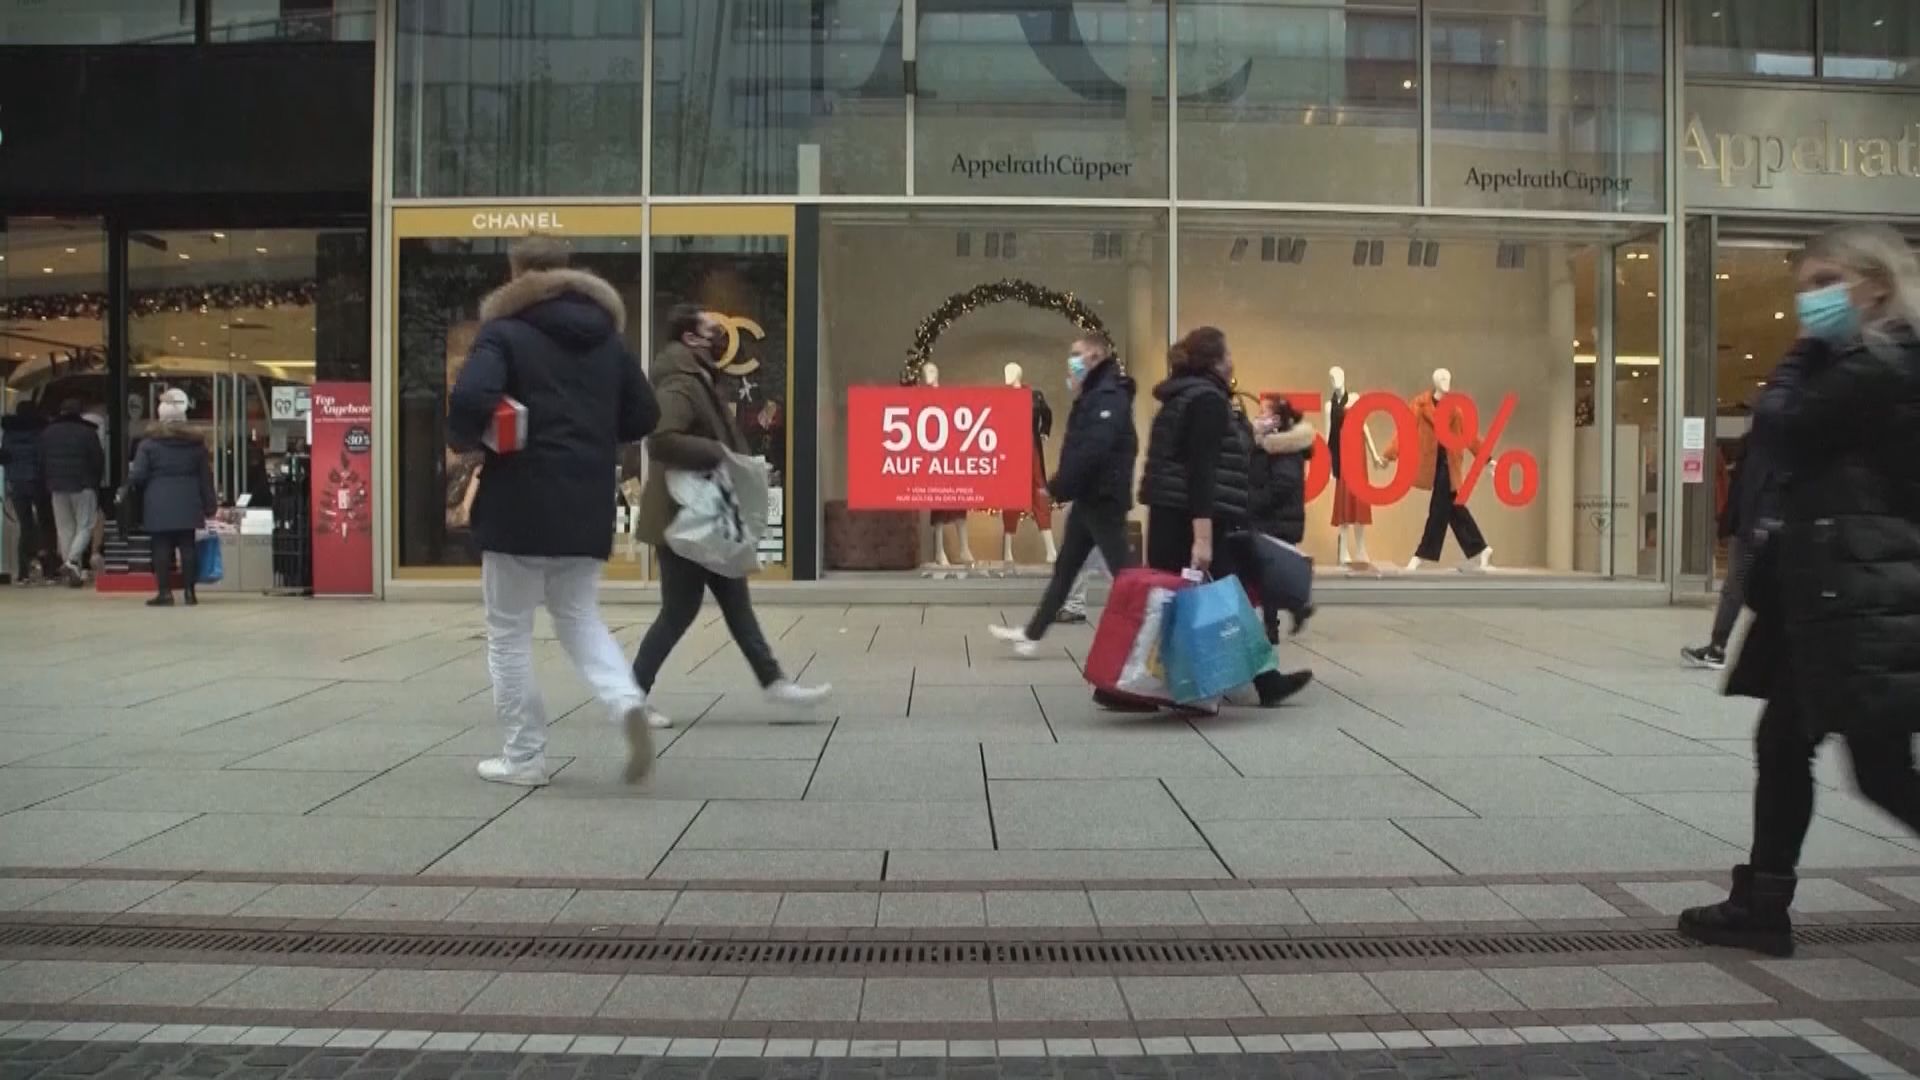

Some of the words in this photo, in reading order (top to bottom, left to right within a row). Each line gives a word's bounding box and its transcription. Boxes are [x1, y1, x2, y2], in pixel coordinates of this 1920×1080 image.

[1681, 112, 1920, 189] Appelrat
[951, 153, 1133, 181] AppelrathCüpper
[1464, 166, 1633, 196] AppelrathCüpper
[472, 212, 565, 230] CHANEL
[314, 394, 336, 405] Top
[881, 405, 998, 453] 50%
[882, 456, 923, 475] AUF
